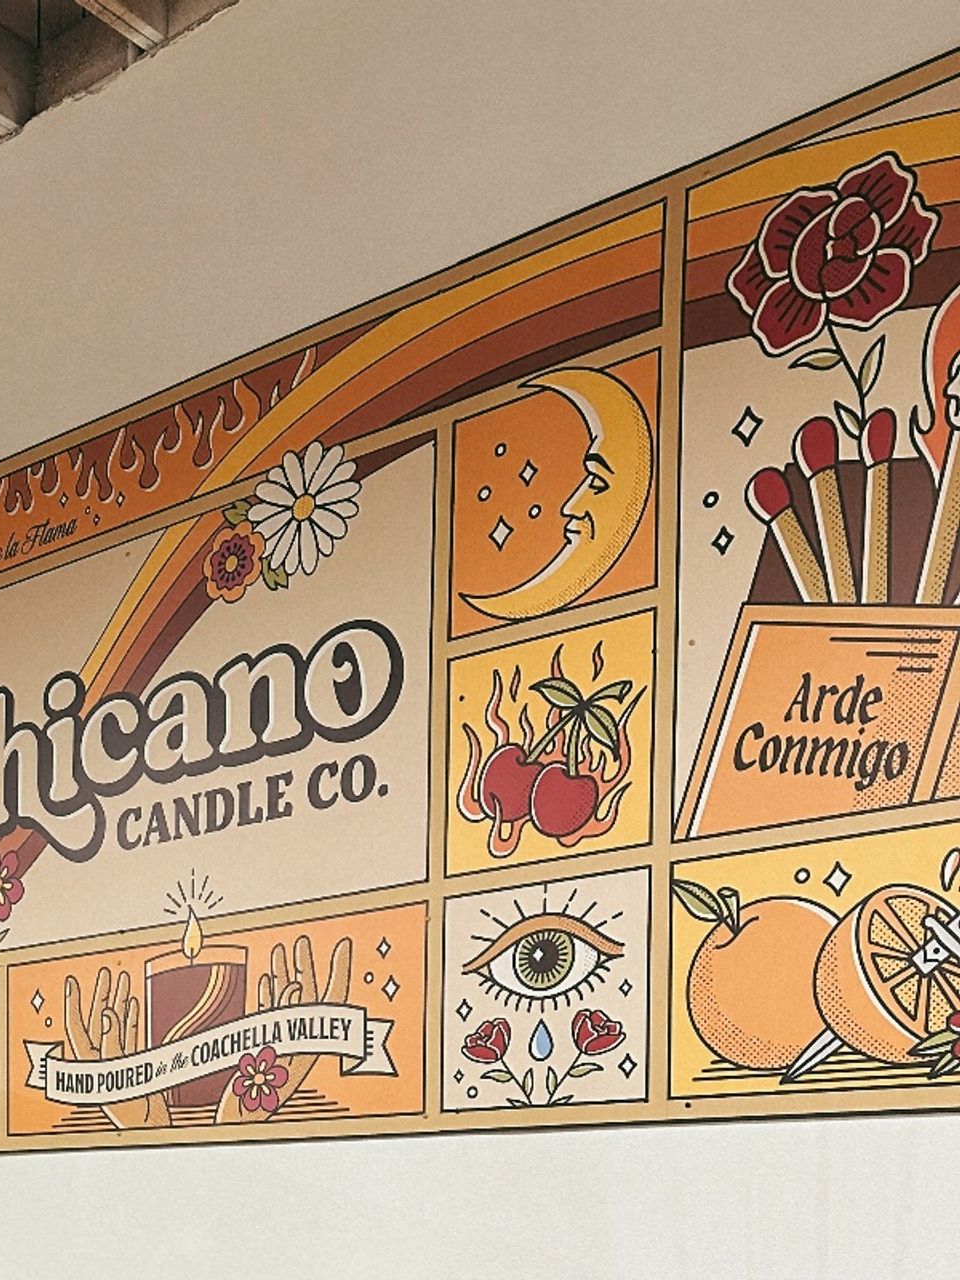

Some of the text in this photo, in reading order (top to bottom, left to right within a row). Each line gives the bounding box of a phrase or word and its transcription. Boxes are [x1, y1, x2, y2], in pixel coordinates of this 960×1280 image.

[4, 532, 19, 560] la
[20, 516, 78, 554] Flama
[784, 672, 883, 725] Arde
[733, 721, 911, 792] Conmigo
[116, 753, 389, 851] CANDLE CO.
[55, 1017, 352, 1094] HAND POURED in the COACHELLA VALLEY
